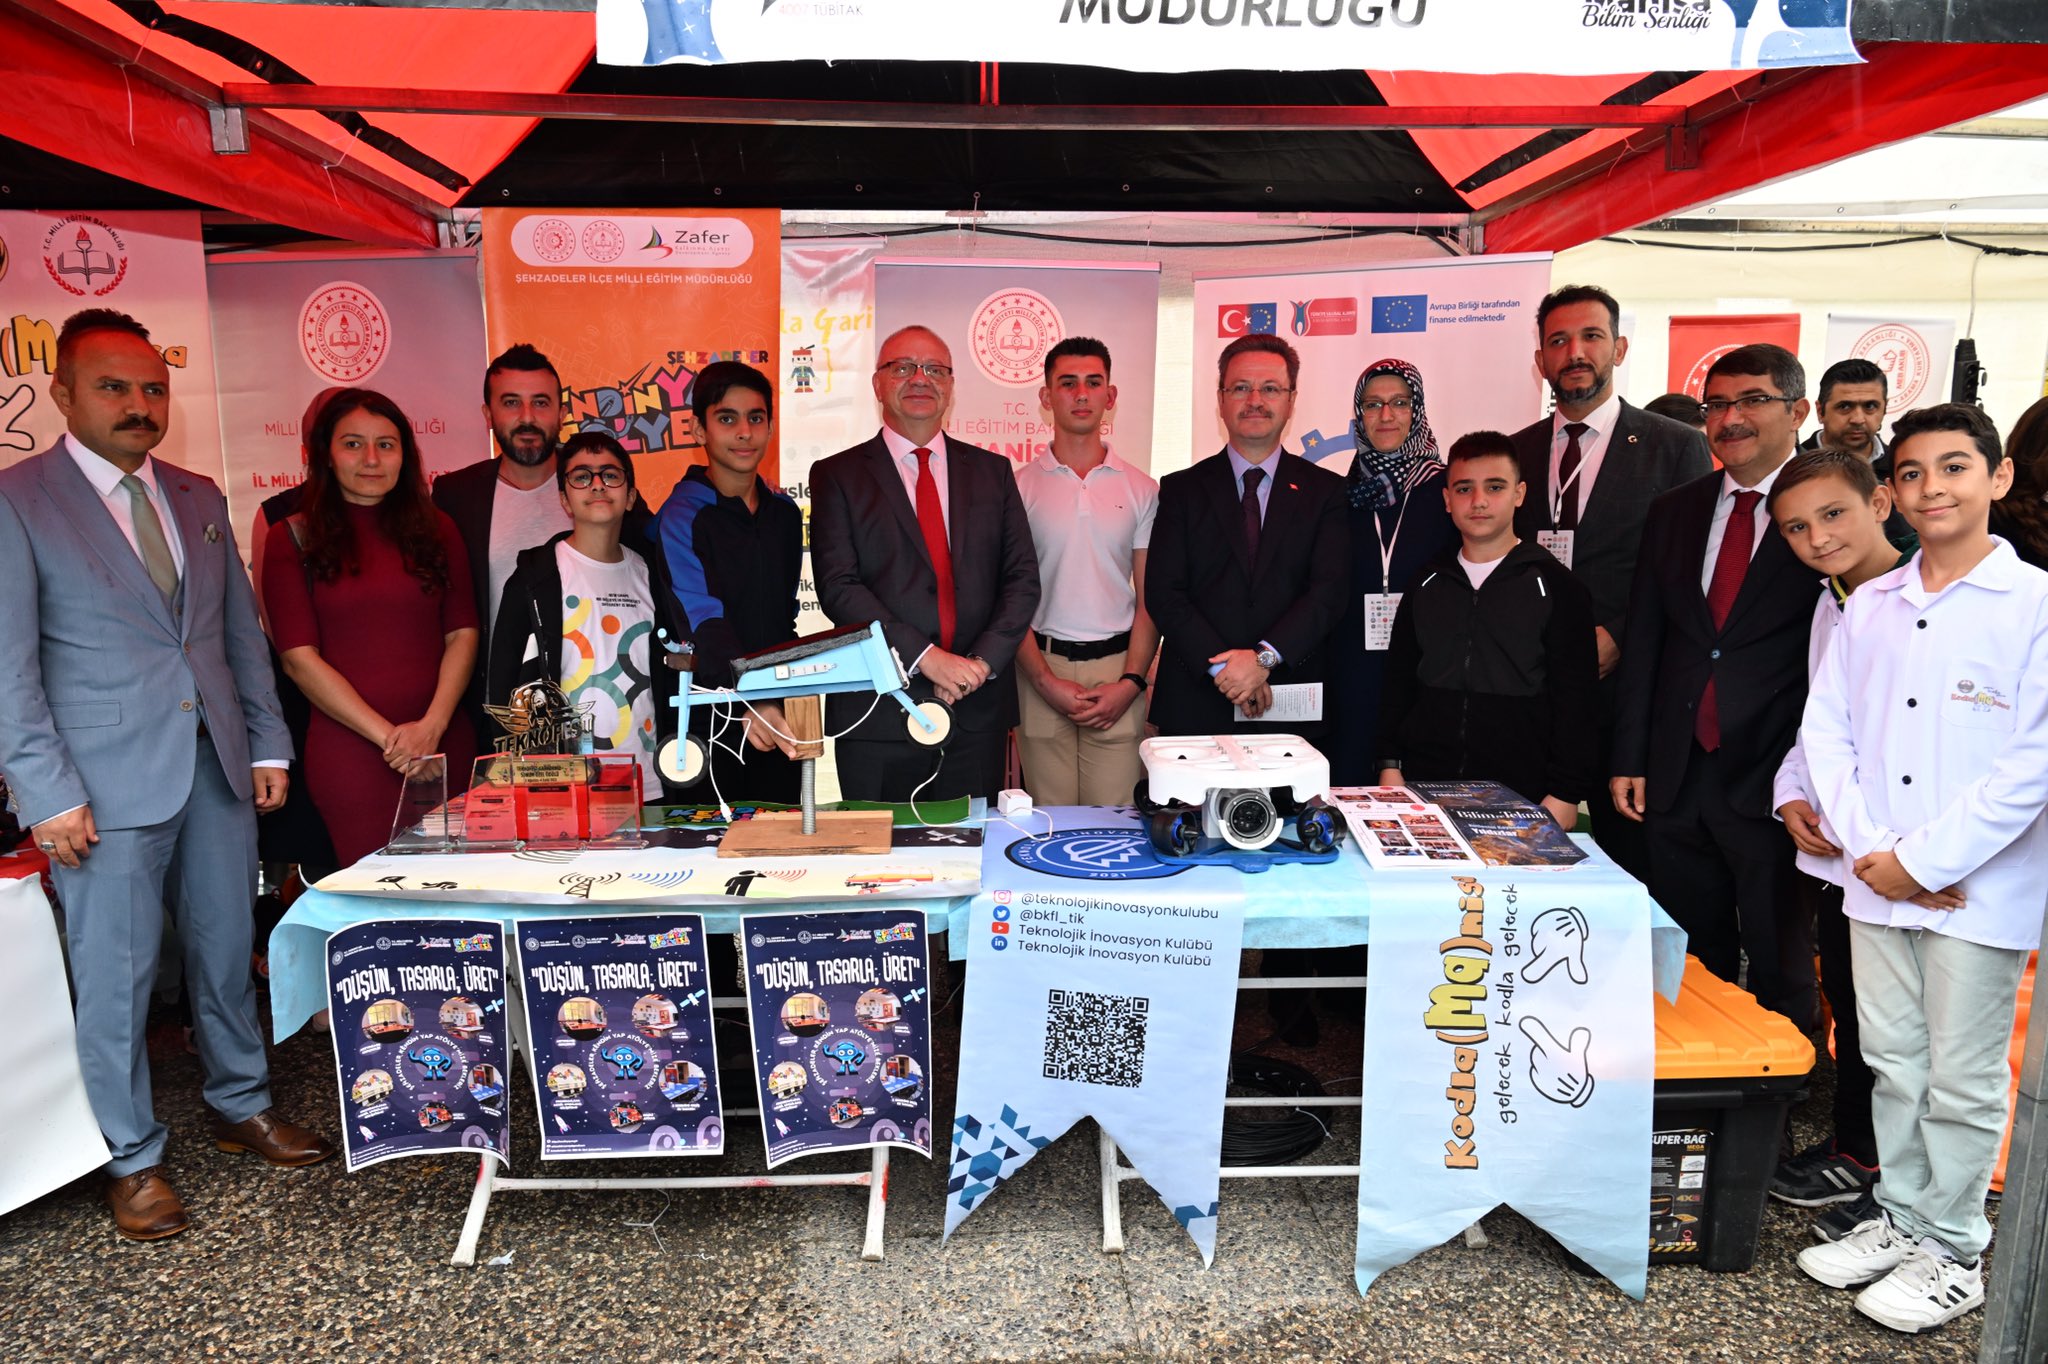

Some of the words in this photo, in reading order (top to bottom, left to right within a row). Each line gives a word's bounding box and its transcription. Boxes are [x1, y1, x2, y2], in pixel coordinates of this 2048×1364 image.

[1582, 4, 1636, 27] Bilim
[48, 219, 66, 237] MİLLİ
[66, 212, 92, 224] EĞİTİM
[93, 216, 125, 251] BAKANLIĞI
[675, 229, 730, 244] Zafer
[515, 273, 586, 284] ŞEHZADELER
[589, 271, 613, 284] İLÇE
[616, 271, 643, 284] MİLLİ
[646, 271, 683, 284] EĞİTİM
[687, 272, 753, 284] MÜDÜRLÜĞÜ
[1429, 301, 1456, 312] Avrupa
[1458, 299, 1480, 312] Birliği
[1481, 299, 1520, 310] tarafından
[814, 306, 872, 345] Gari
[1429, 314, 1456, 324] finanse
[1458, 312, 1506, 324] edilmektedir
[667, 350, 769, 366] ŞEHZADELER
[1003, 402, 1029, 415] T.C.
[265, 420, 299, 436] MİLLİ
[966, 419, 1020, 435] EĞİTİM
[252, 473, 268, 488] İL
[1456, 810, 1496, 819] Bilim
[1502, 811, 1548, 819] Teknik
[1471, 828, 1518, 838] Yıldızlar
[1021, 892, 1219, 919] @teknolojikinovasyonkulubu
[1020, 909, 1085, 925] @bkfl_tik
[1495, 882, 1521, 957] gelecek
[1019, 924, 1086, 942] Teknolojik
[1090, 929, 1161, 949] İnovasyon
[1165, 938, 1213, 951] Kulübü
[1017, 940, 1085, 958] Teknolojik
[1088, 945, 1160, 964] İnovasyon
[1164, 953, 1211, 966] Kulübü
[531, 961, 590, 996] "DÜŞÜN,
[591, 962, 655, 991] TASARLA,
[657, 957, 697, 989] ÜRET"
[756, 957, 814, 992] "DÜŞÜN,
[816, 957, 879, 986] TASARLA,
[882, 952, 920, 983] ÜRET"
[336, 964, 396, 1005] "DÜŞÜN,
[397, 965, 461, 994] TASARLA,
[463, 961, 499, 993] ÜRET"
[1494, 970, 1515, 1027] kodla
[1493, 1041, 1517, 1124] gelecek
